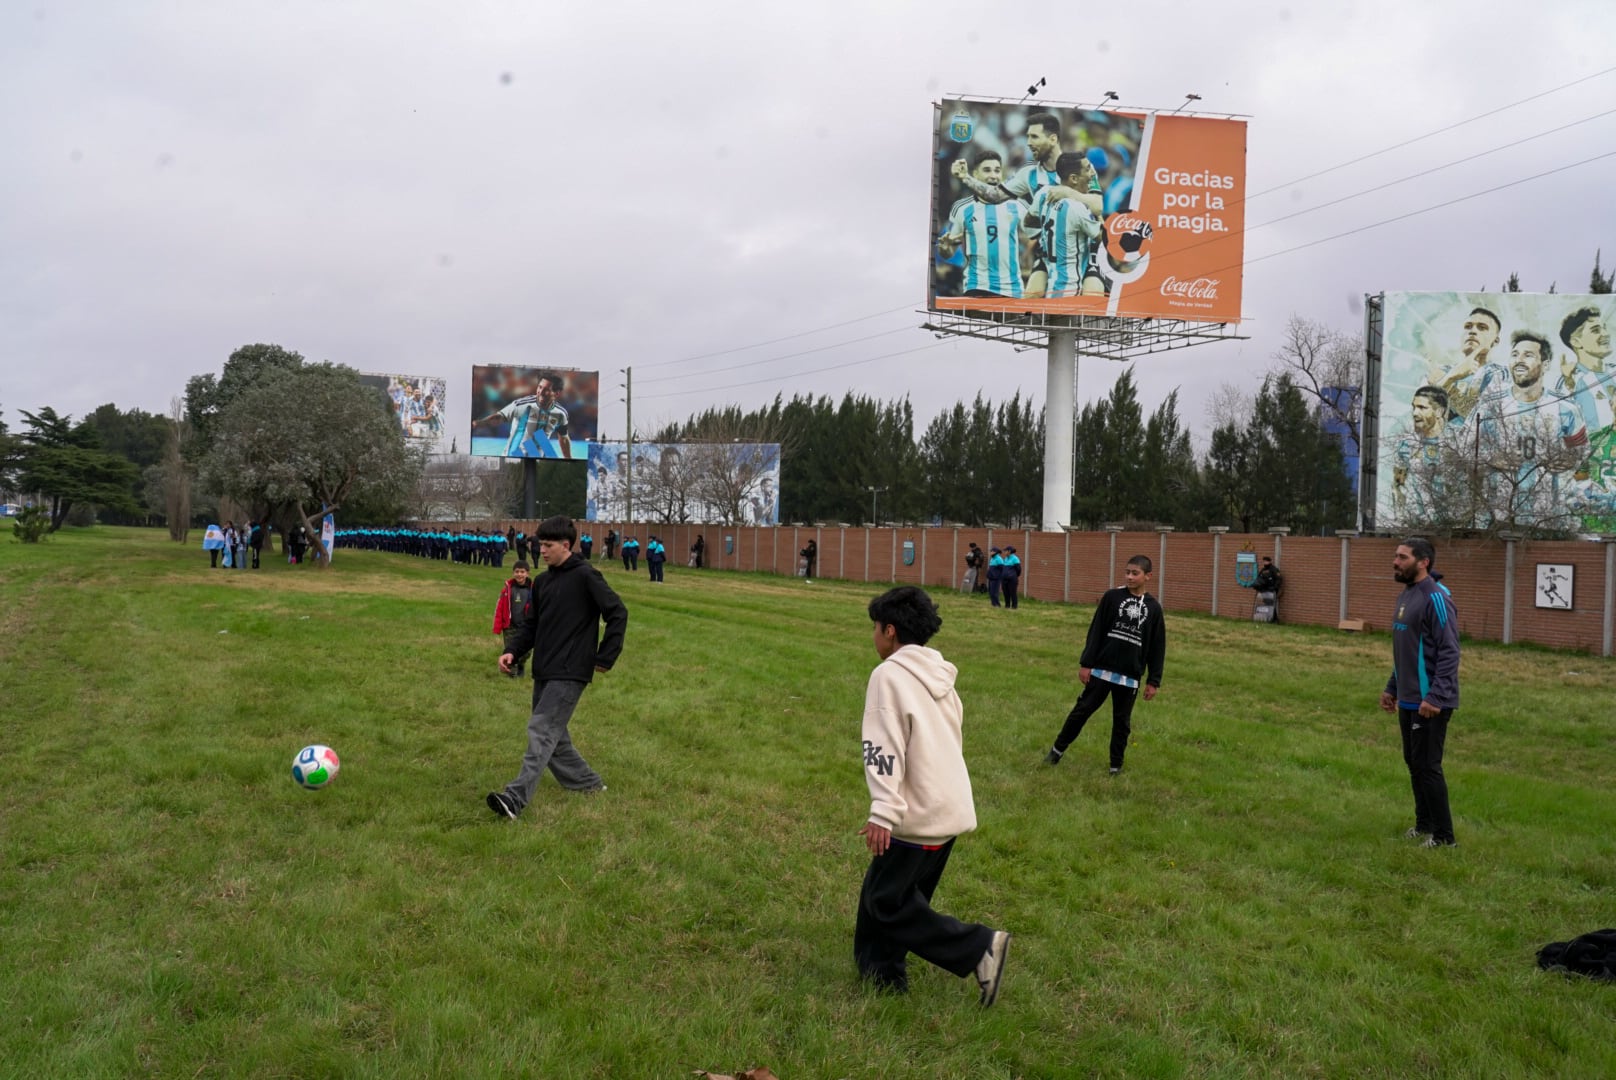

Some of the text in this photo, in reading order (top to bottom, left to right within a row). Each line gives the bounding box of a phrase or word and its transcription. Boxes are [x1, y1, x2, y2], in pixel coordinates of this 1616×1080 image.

[1154, 167, 1234, 190] Gracias
[1163, 191, 1225, 210] por la
[1158, 213, 1229, 234] magia.
[987, 225, 998, 244] 9
[1160, 275, 1221, 299] Coca-Cola
